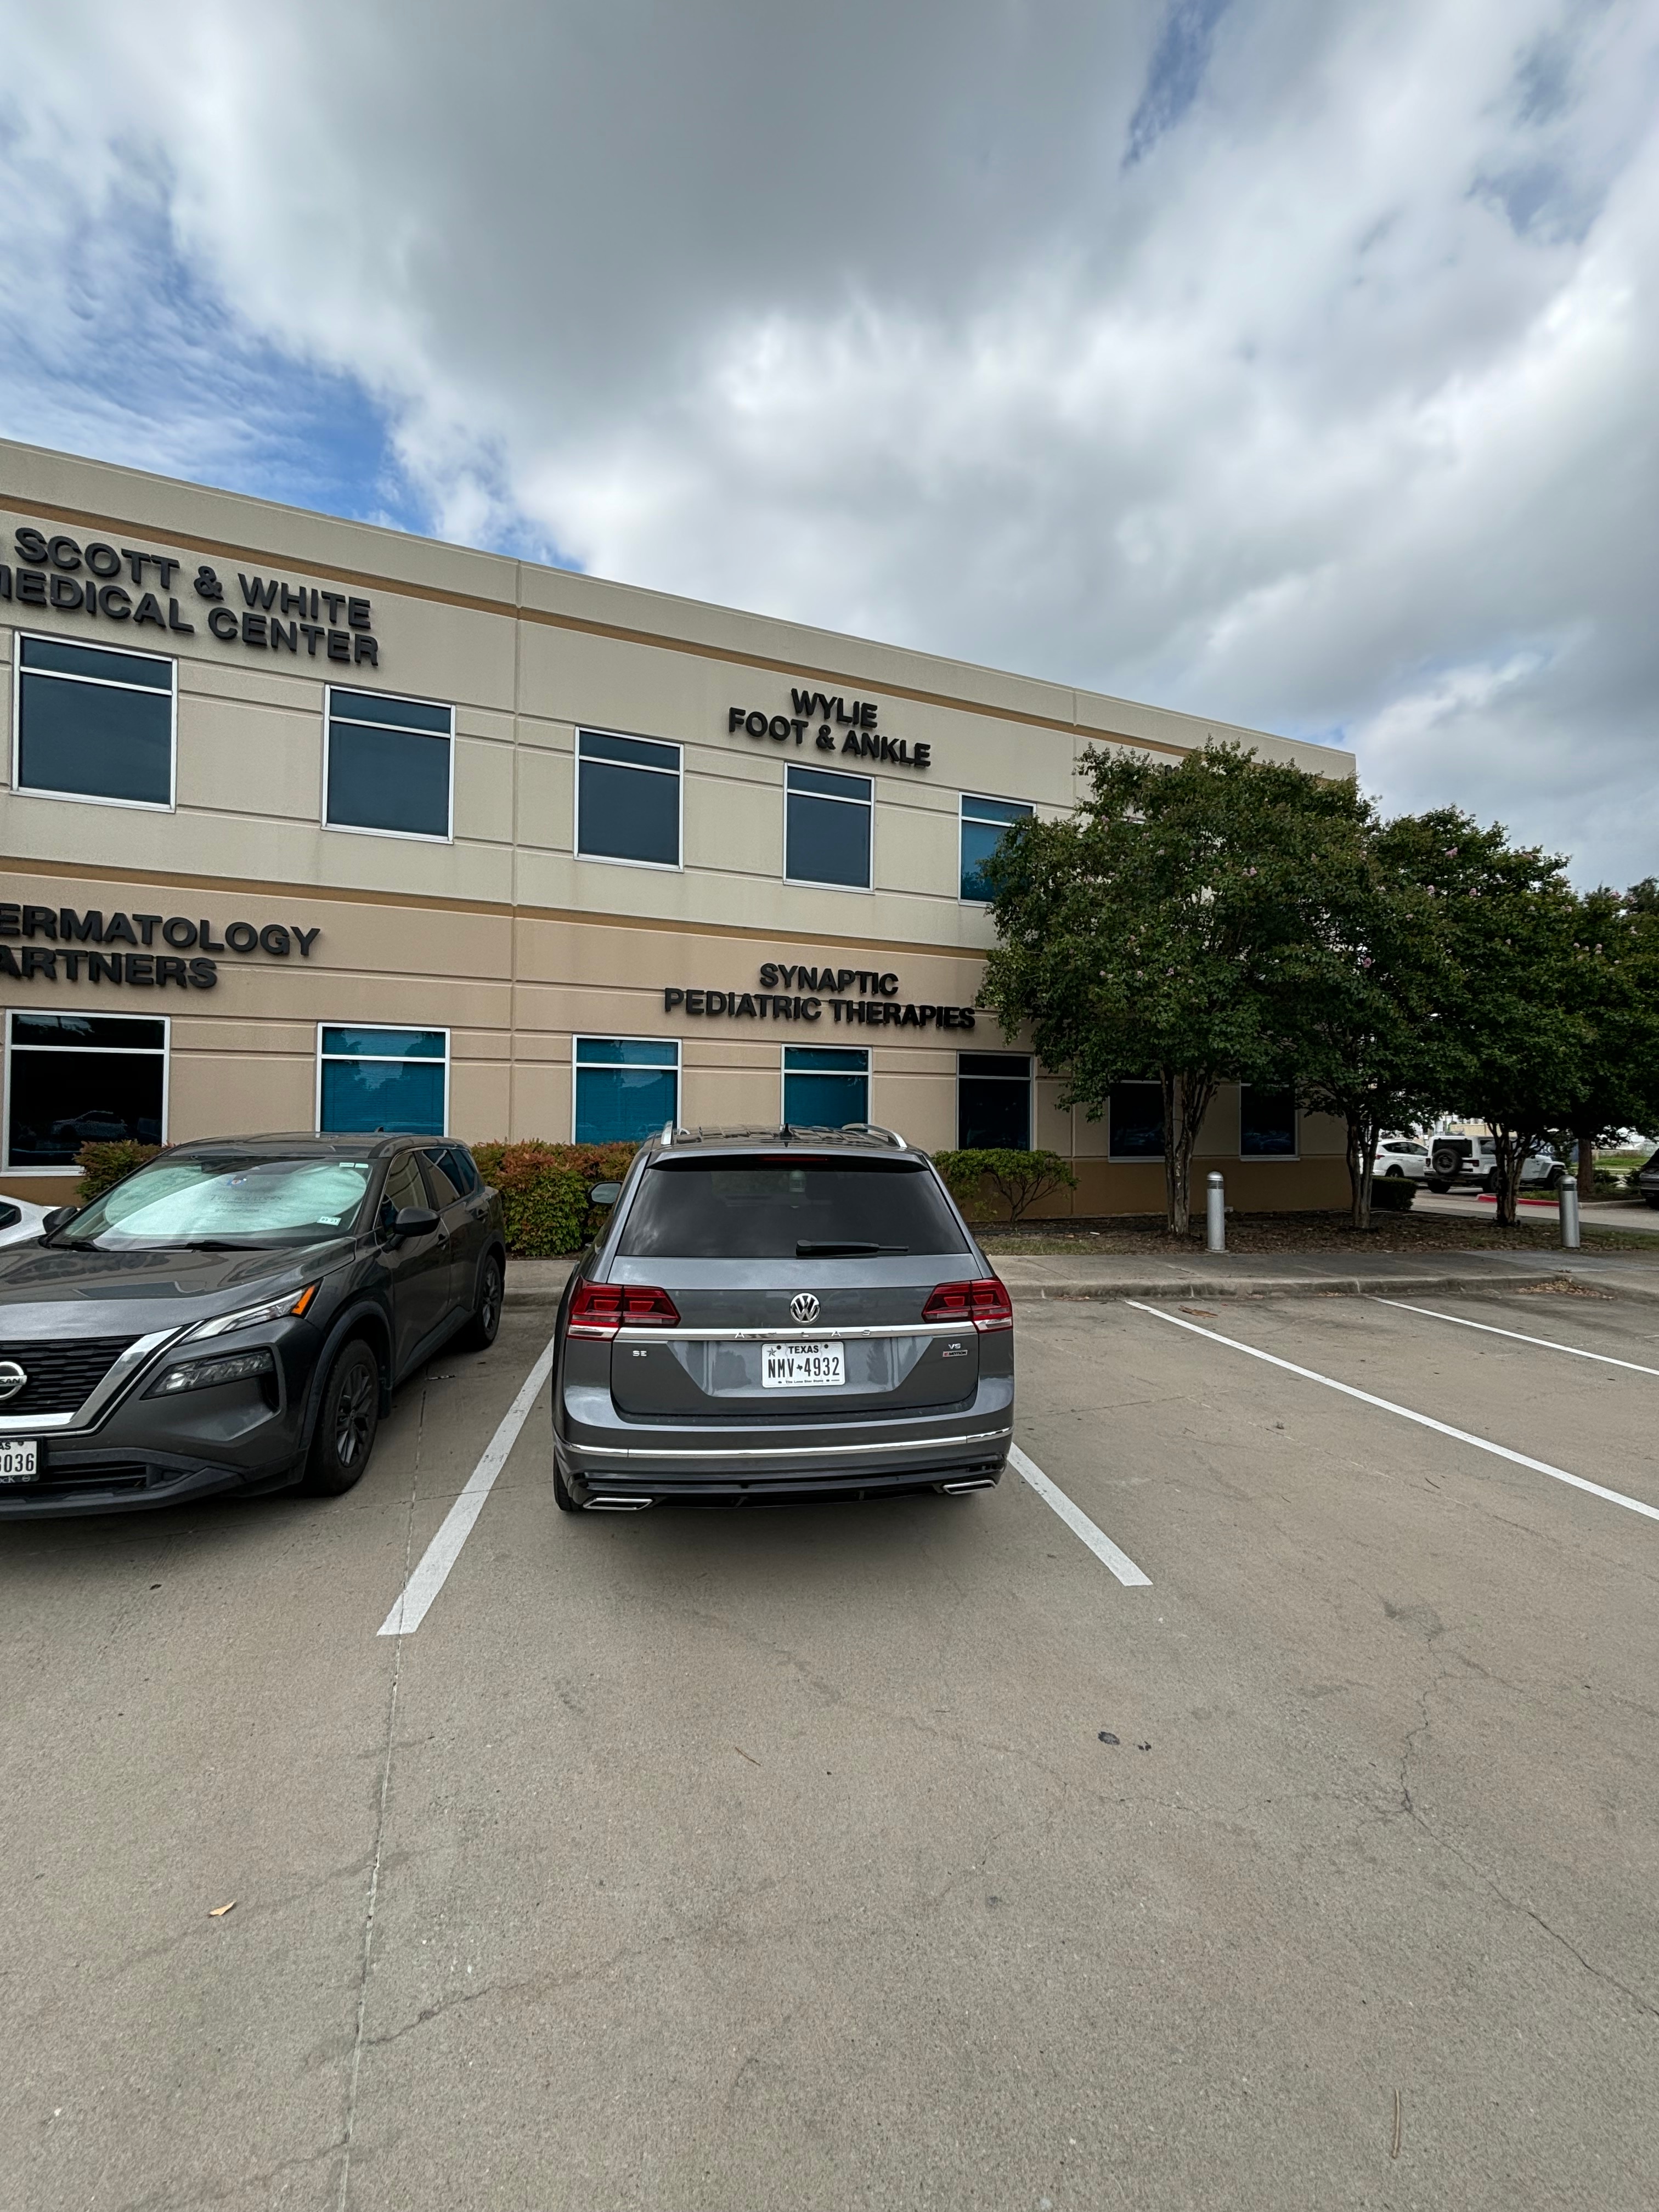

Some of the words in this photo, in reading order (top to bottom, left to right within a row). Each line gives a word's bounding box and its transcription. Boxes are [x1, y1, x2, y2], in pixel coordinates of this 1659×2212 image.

[14, 527, 180, 589] SCOTT
[194, 566, 224, 600] &
[238, 573, 371, 629] WHITE
[208, 607, 379, 666] CENTER
[791, 688, 878, 729] WYLIE
[729, 707, 809, 744] FOOT
[816, 724, 836, 750] &
[842, 730, 931, 767] ANKLE
[759, 963, 899, 996] SYNAPTIC
[664, 988, 822, 1020] PEDIATRIC
[829, 998, 975, 1029] THERAPIES
[735, 1329, 871, 1339] ALAS
[788, 1345, 819, 1354] TEXAS
[768, 1358, 794, 1378] NMV
[804, 1357, 840, 1377] 4932
[0, 1453, 34, 1473] 036
